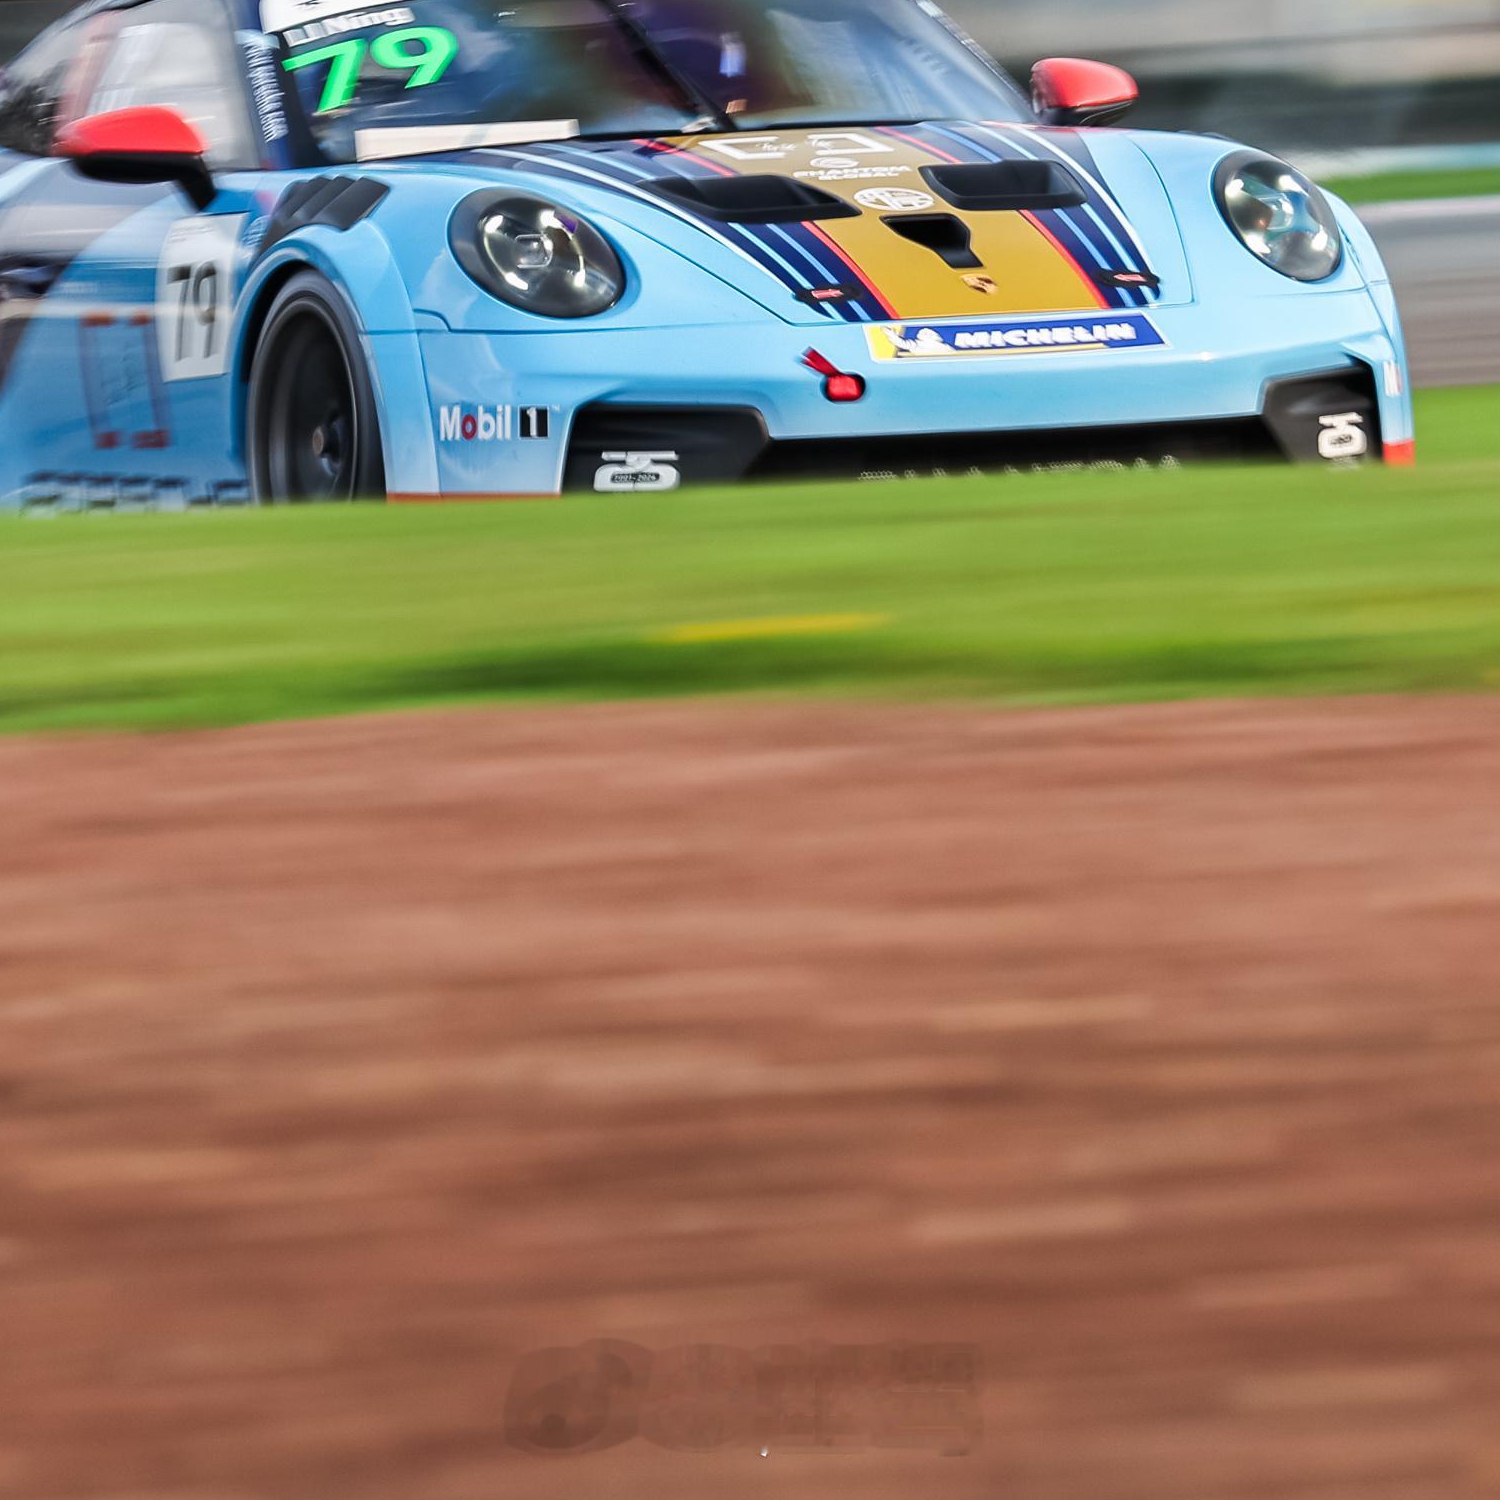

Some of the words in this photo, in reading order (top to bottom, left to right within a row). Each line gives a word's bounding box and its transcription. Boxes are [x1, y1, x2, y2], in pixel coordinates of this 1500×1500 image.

[281, 25, 459, 113] 79
[167, 259, 217, 362] 79
[953, 322, 1138, 349] MICHELIN
[438, 403, 512, 441] Mobil
